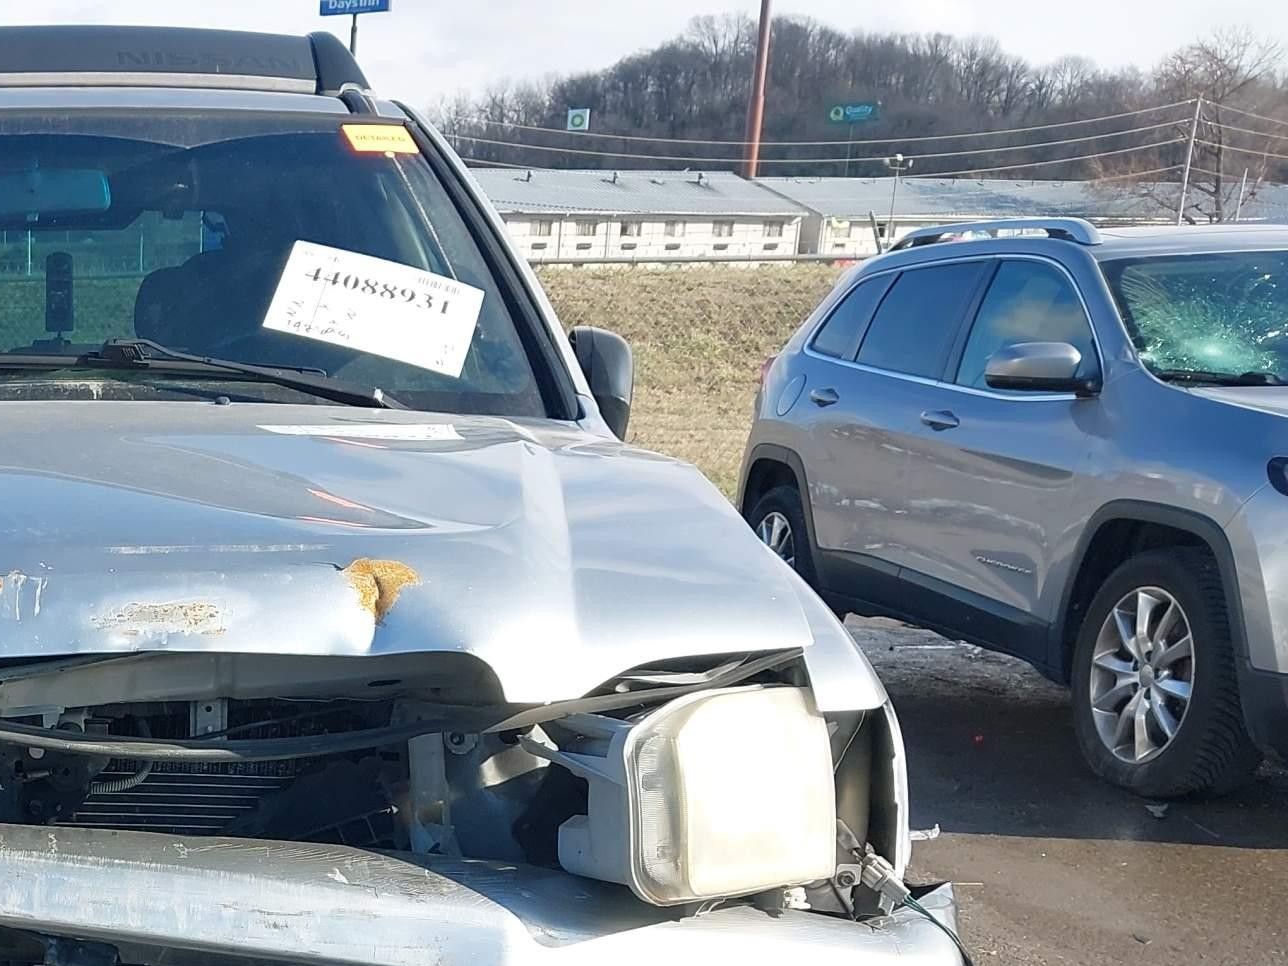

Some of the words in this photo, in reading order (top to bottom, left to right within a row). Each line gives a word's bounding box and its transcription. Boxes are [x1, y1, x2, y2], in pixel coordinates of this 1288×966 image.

[328, 0, 356, 9] Days
[116, 51, 302, 73] NISSAN
[304, 266, 451, 315] 44088931
